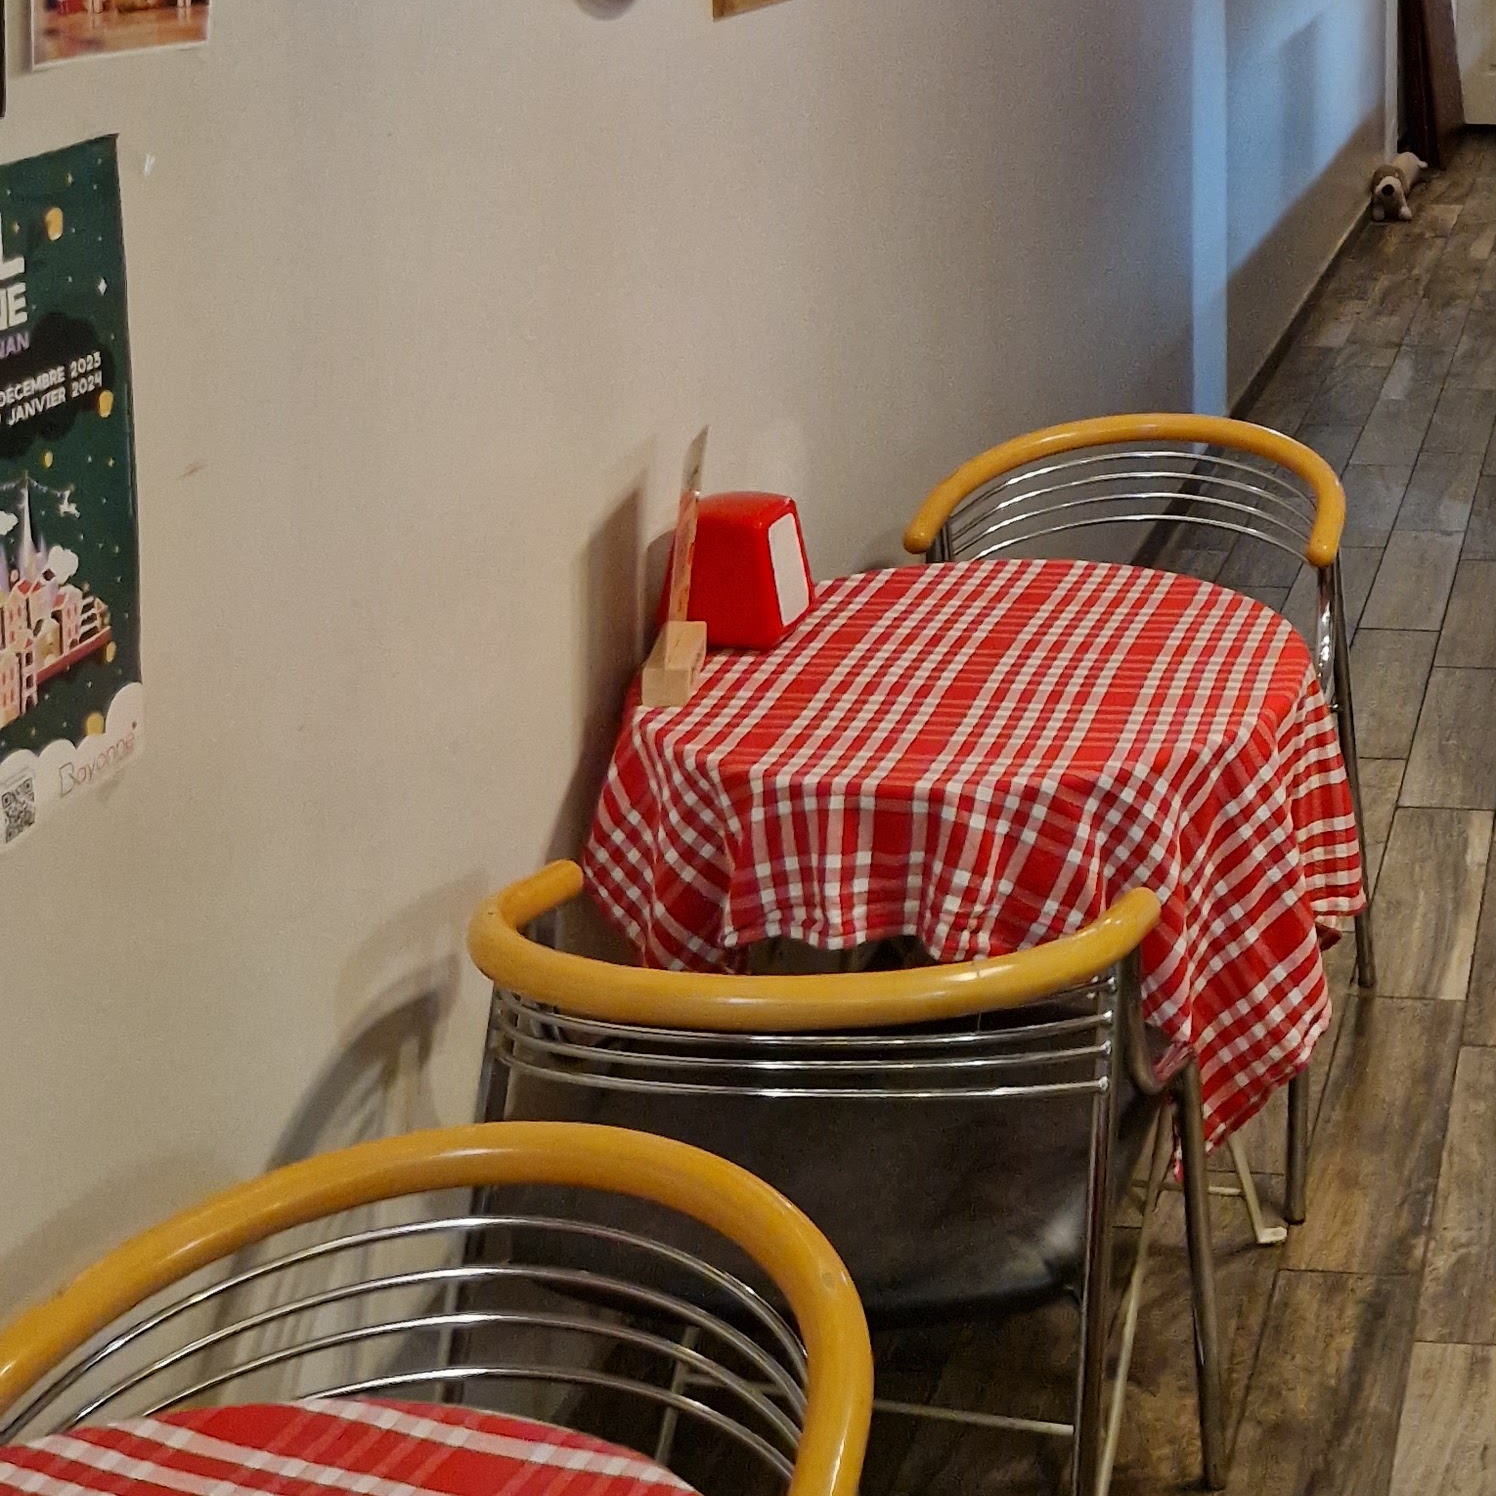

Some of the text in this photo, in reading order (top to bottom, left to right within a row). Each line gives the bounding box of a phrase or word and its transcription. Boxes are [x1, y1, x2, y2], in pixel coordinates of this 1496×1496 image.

[7, 370, 103, 427] JANVIER 2024
[59, 732, 135, 798] Bayonne
